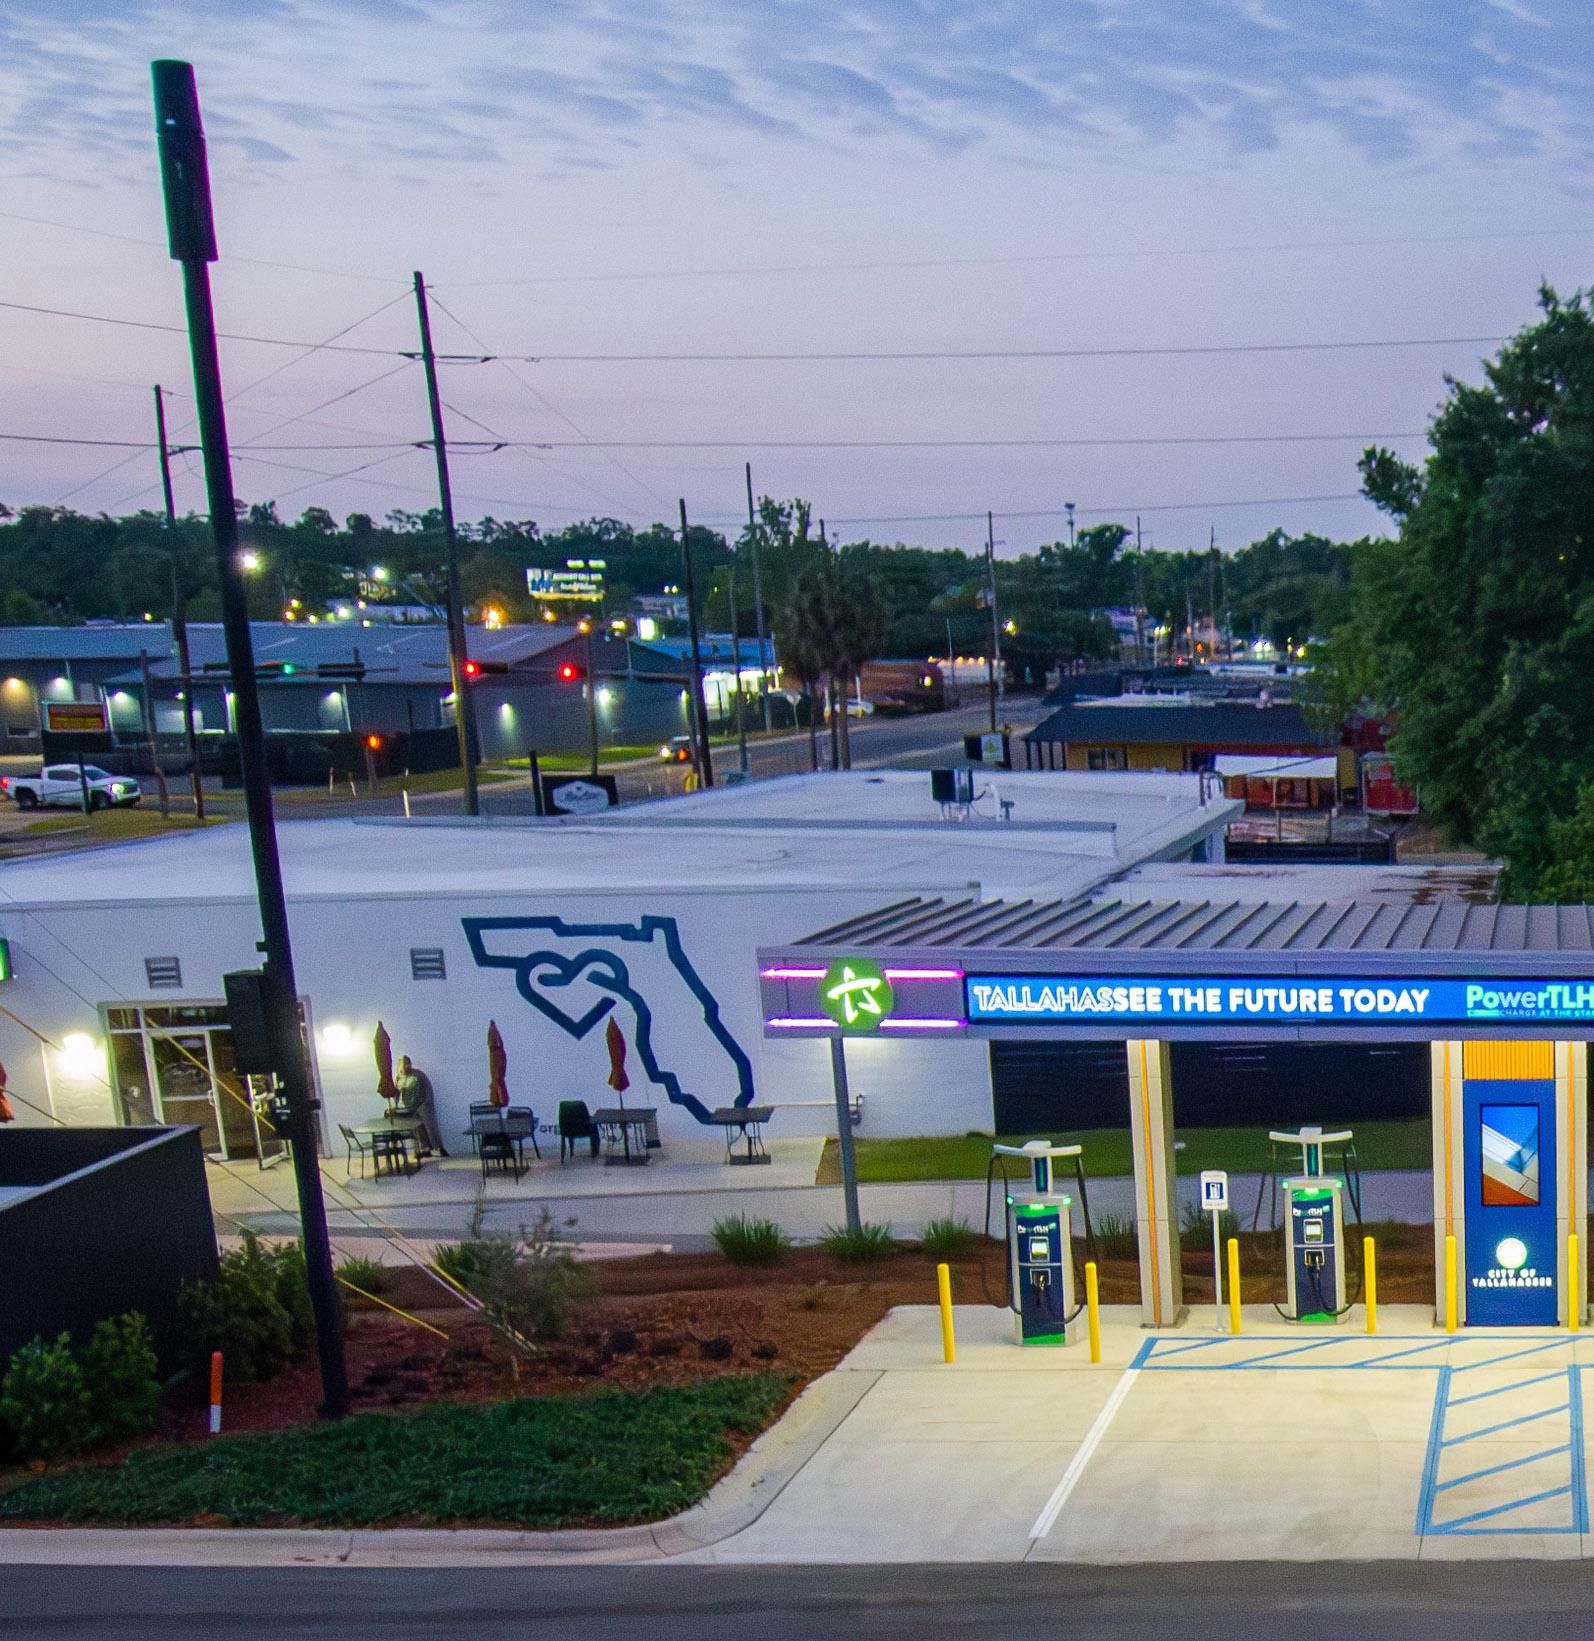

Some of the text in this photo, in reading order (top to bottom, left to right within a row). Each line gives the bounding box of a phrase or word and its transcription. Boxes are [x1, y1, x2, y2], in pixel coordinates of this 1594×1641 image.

[973, 985, 1430, 1013] TALLAHASSEE THE FUTURE TODAY
[1499, 1009, 1537, 1017] CHARGE
[1539, 1009, 1552, 1017] AT
[1488, 1269, 1536, 1278] CITY OF
[1472, 1277, 1552, 1287] TALLAHASSEE
